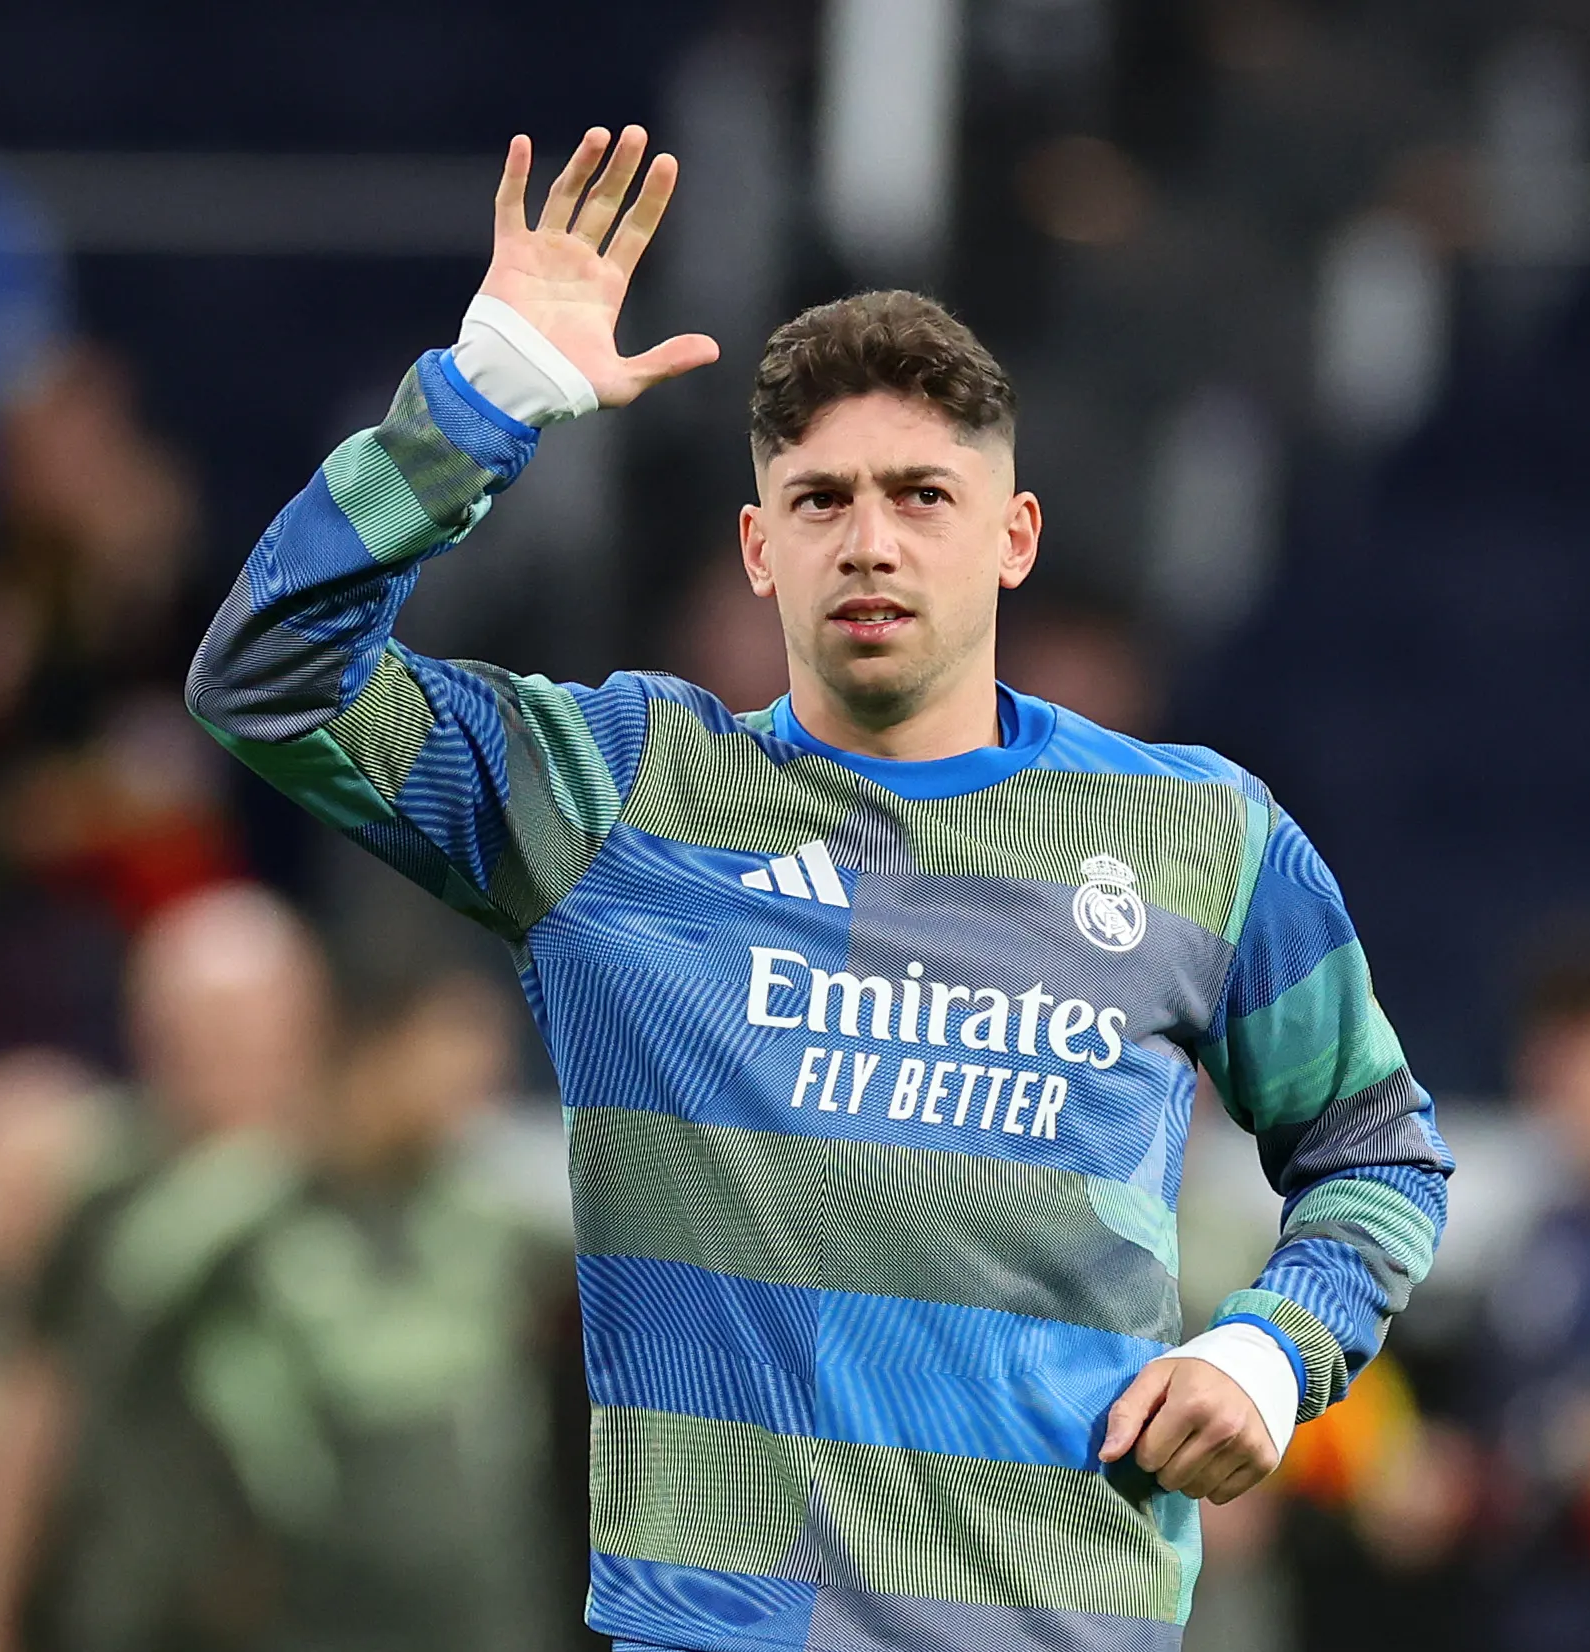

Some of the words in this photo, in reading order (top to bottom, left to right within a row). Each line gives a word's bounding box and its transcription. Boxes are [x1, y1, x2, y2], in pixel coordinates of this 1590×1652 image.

[746, 945, 1127, 1070] Emirates
[790, 1047, 880, 1115] FLY
[887, 1058, 1069, 1141] BETTER
